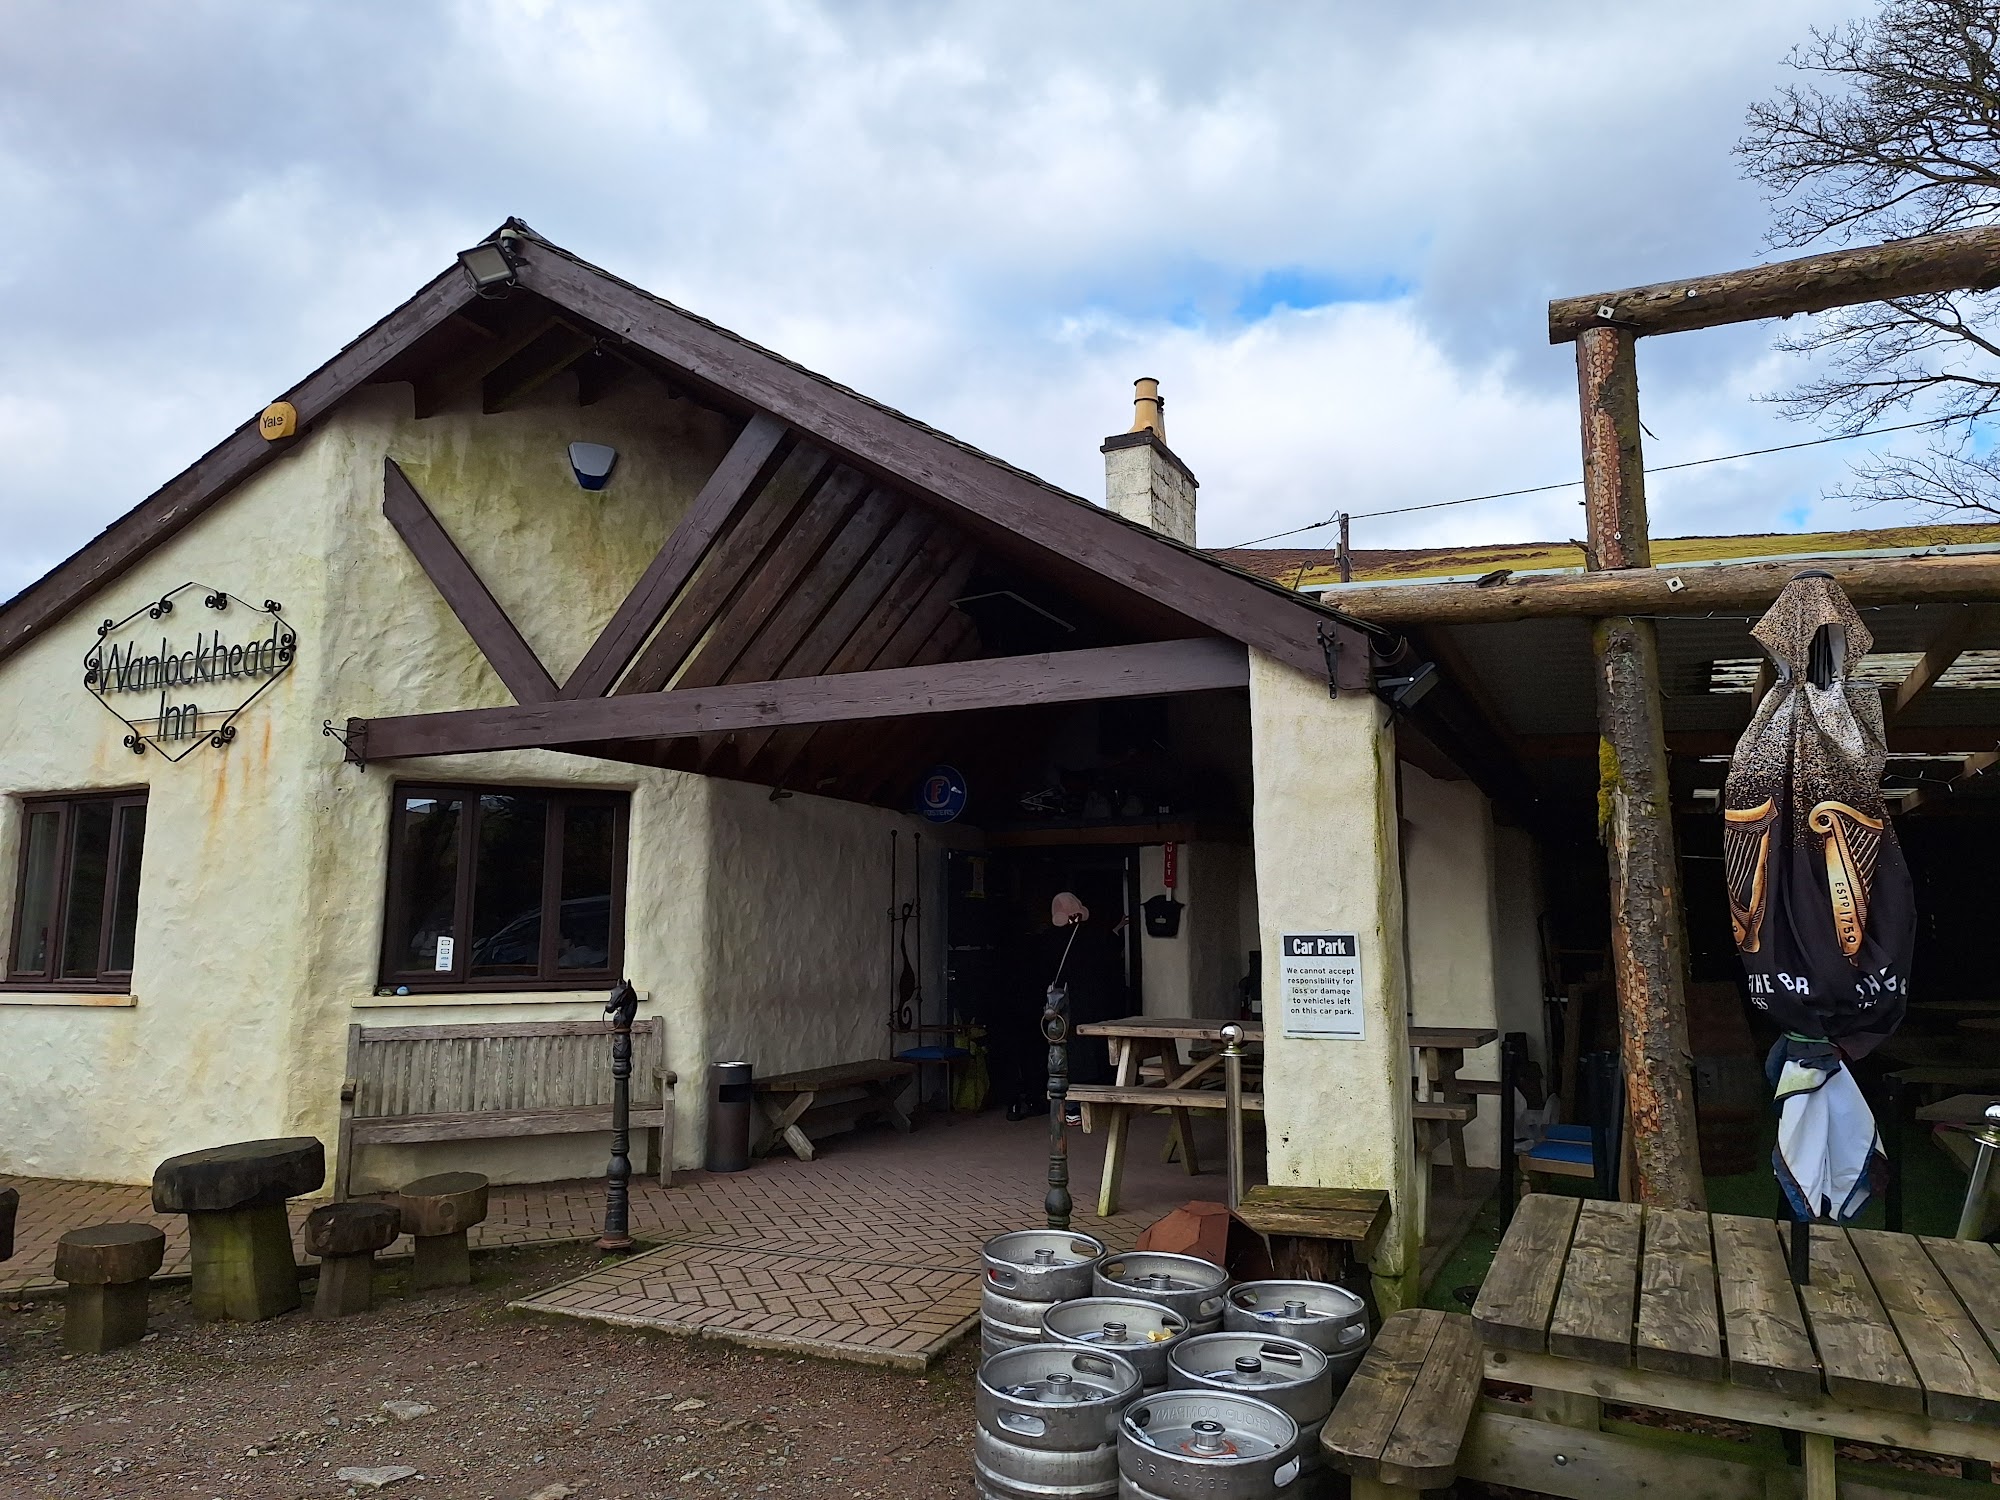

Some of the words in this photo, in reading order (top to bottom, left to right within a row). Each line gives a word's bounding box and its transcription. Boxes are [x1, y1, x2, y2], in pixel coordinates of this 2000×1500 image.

[262, 415, 284, 429] Yale
[98, 620, 279, 695] Wanlockhead
[157, 690, 198, 742] Inn
[1839, 911, 1857, 943] 1759
[1292, 938, 1314, 955] Car
[1316, 938, 1347, 955] Park
[1328, 968, 1355, 976] accept
[1287, 977, 1340, 985] responsibility
[1320, 988, 1351, 996] damage
[1335, 1008, 1355, 1016] park.
